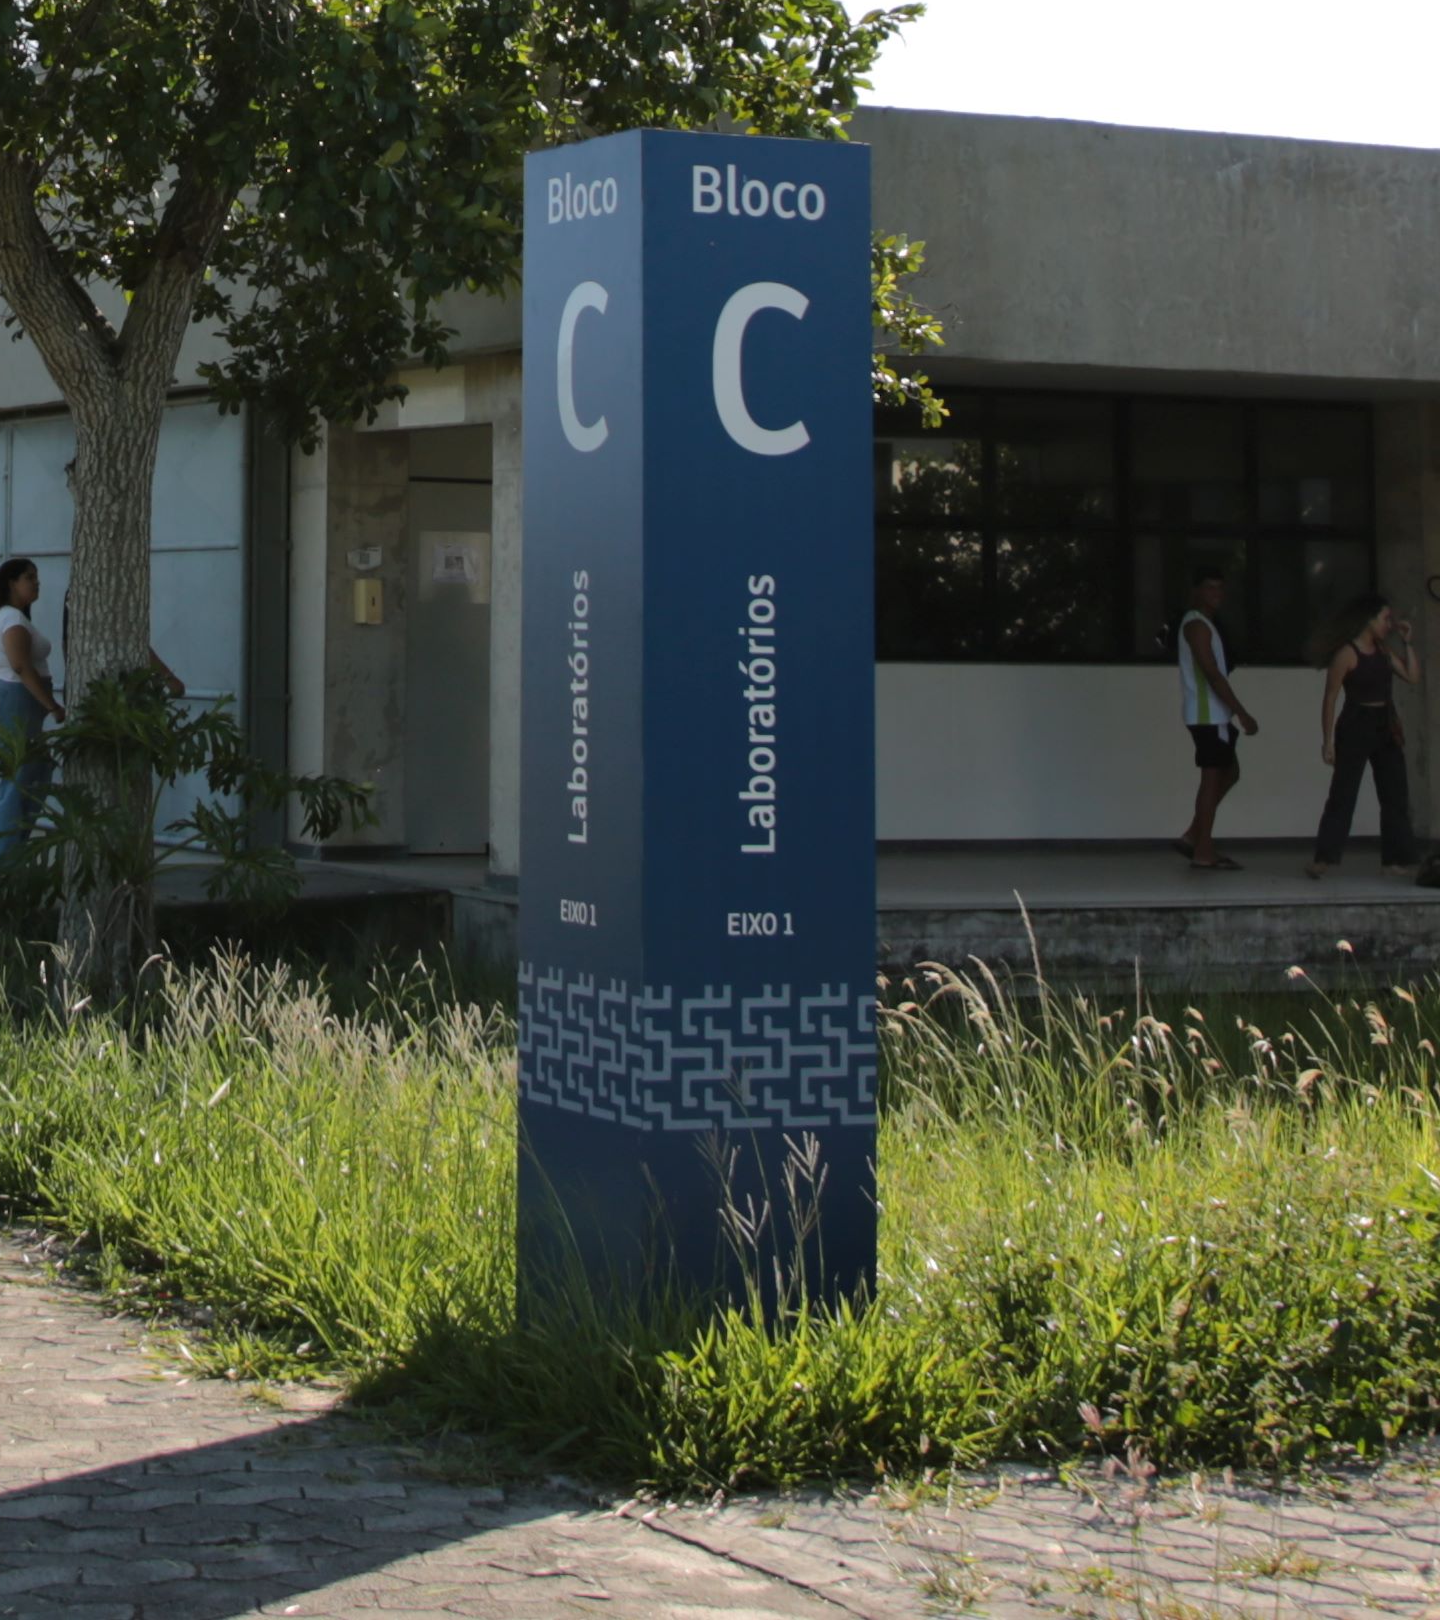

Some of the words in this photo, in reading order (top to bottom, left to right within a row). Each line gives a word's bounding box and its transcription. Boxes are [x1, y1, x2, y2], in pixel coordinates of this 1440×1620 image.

[548, 173, 617, 224] Bloco
[692, 164, 826, 221] Bloco
[557, 281, 609, 453] C
[712, 281, 811, 456] C
[567, 569, 589, 844] Laboratórios
[738, 573, 776, 854] Laboratórios
[560, 899, 588, 925] EIXO
[590, 904, 598, 927] 1
[727, 912, 778, 936] EIXO
[783, 912, 795, 936] 1
